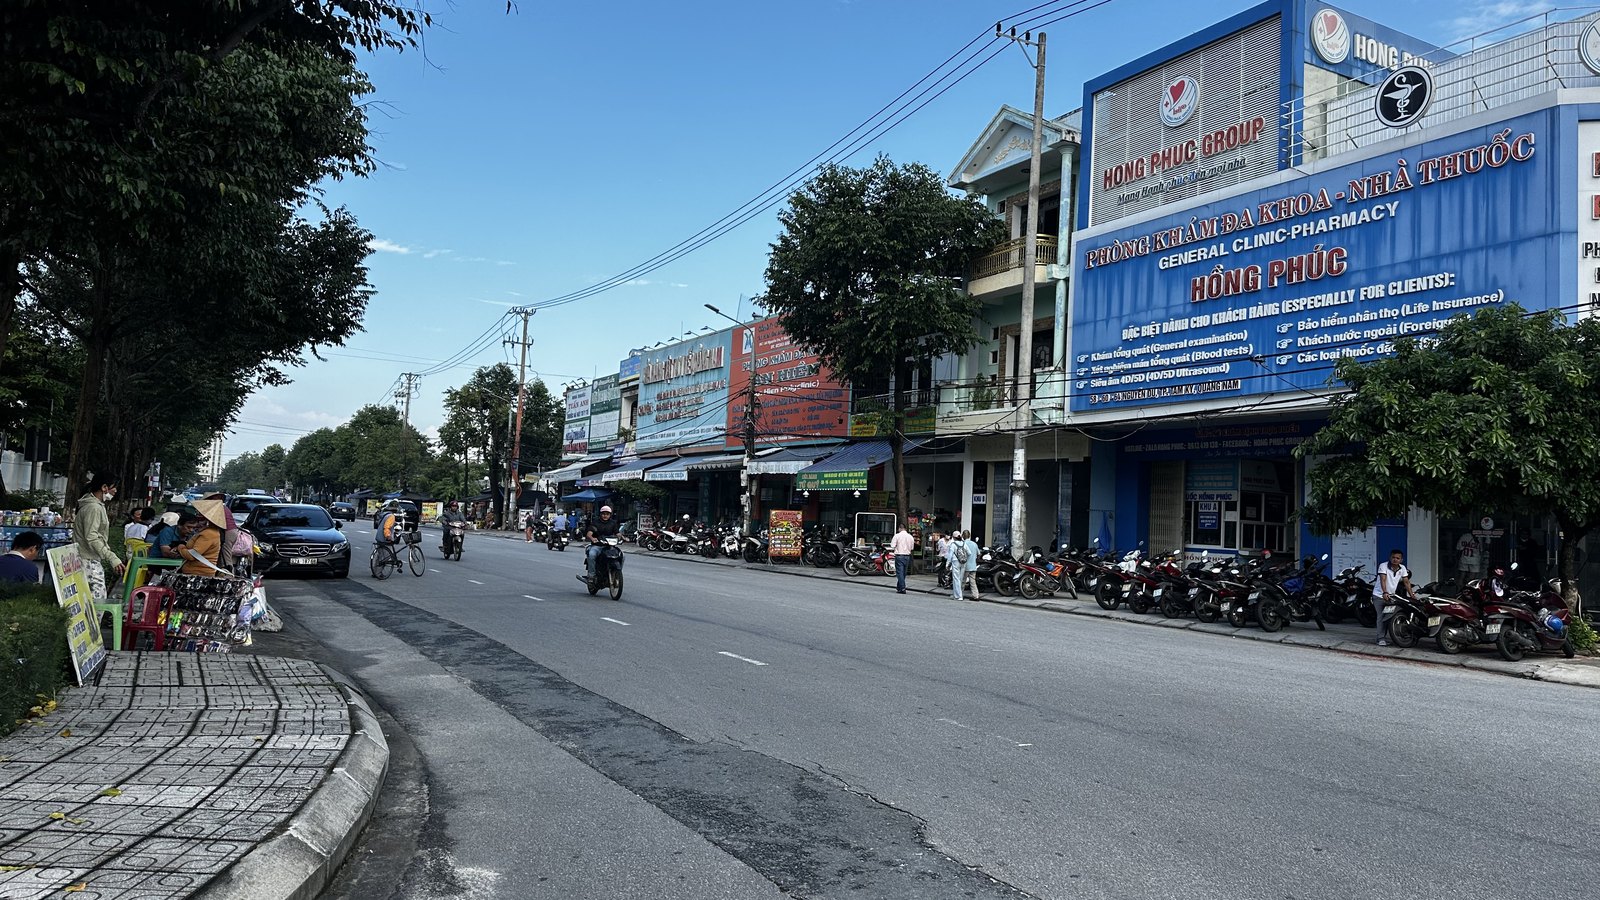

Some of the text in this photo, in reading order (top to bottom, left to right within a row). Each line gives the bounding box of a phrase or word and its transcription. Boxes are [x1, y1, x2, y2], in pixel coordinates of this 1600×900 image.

[1354, 33, 1398, 71] HONG
[1103, 115, 1265, 192] HONG PHUC GROUP
[1085, 236, 1150, 270] PHÒNG
[1151, 216, 1218, 252] KHÁM
[1221, 208, 1254, 235] ĐA
[1257, 187, 1332, 225] KHOA
[1347, 158, 1413, 203] NHÀ
[1417, 127, 1535, 185] THUỐC
[1117, 190, 1140, 206] Mang
[1158, 200, 1400, 271] GENERAL CLINIC-PHARMACY
[1190, 243, 1348, 303] HỒNG PHÚC
[1122, 272, 1455, 341] ĐẶC BIỆT DÀNH CHO KHÁCH HÀNG (ESPECIALLY FOR CLIENTS):
[1297, 289, 1504, 331] Bảo hiểm nhân thọ (Life Insurance)
[1091, 330, 1248, 361] Khám tổng quát (General examination)
[1297, 333, 1332, 347] Khách
[1333, 330, 1362, 343] nước
[1363, 324, 1398, 339] ngoài
[742, 357, 768, 372] PHNG
[1150, 354, 1169, 367] tổng
[1170, 352, 1190, 364] quát
[1191, 347, 1222, 362] (Blood
[1223, 343, 1253, 357] tests)
[1297, 350, 1318, 364] Các
[1319, 348, 1341, 362] loại
[1341, 342, 1374, 358] thuốc
[1120, 373, 1145, 385] 4D/5D
[1146, 370, 1176, 383] (4D/5D
[1176, 362, 1230, 378] Ultrasound)
[1222, 379, 1241, 391] NAM
[1200, 503, 1217, 511] KHU A
